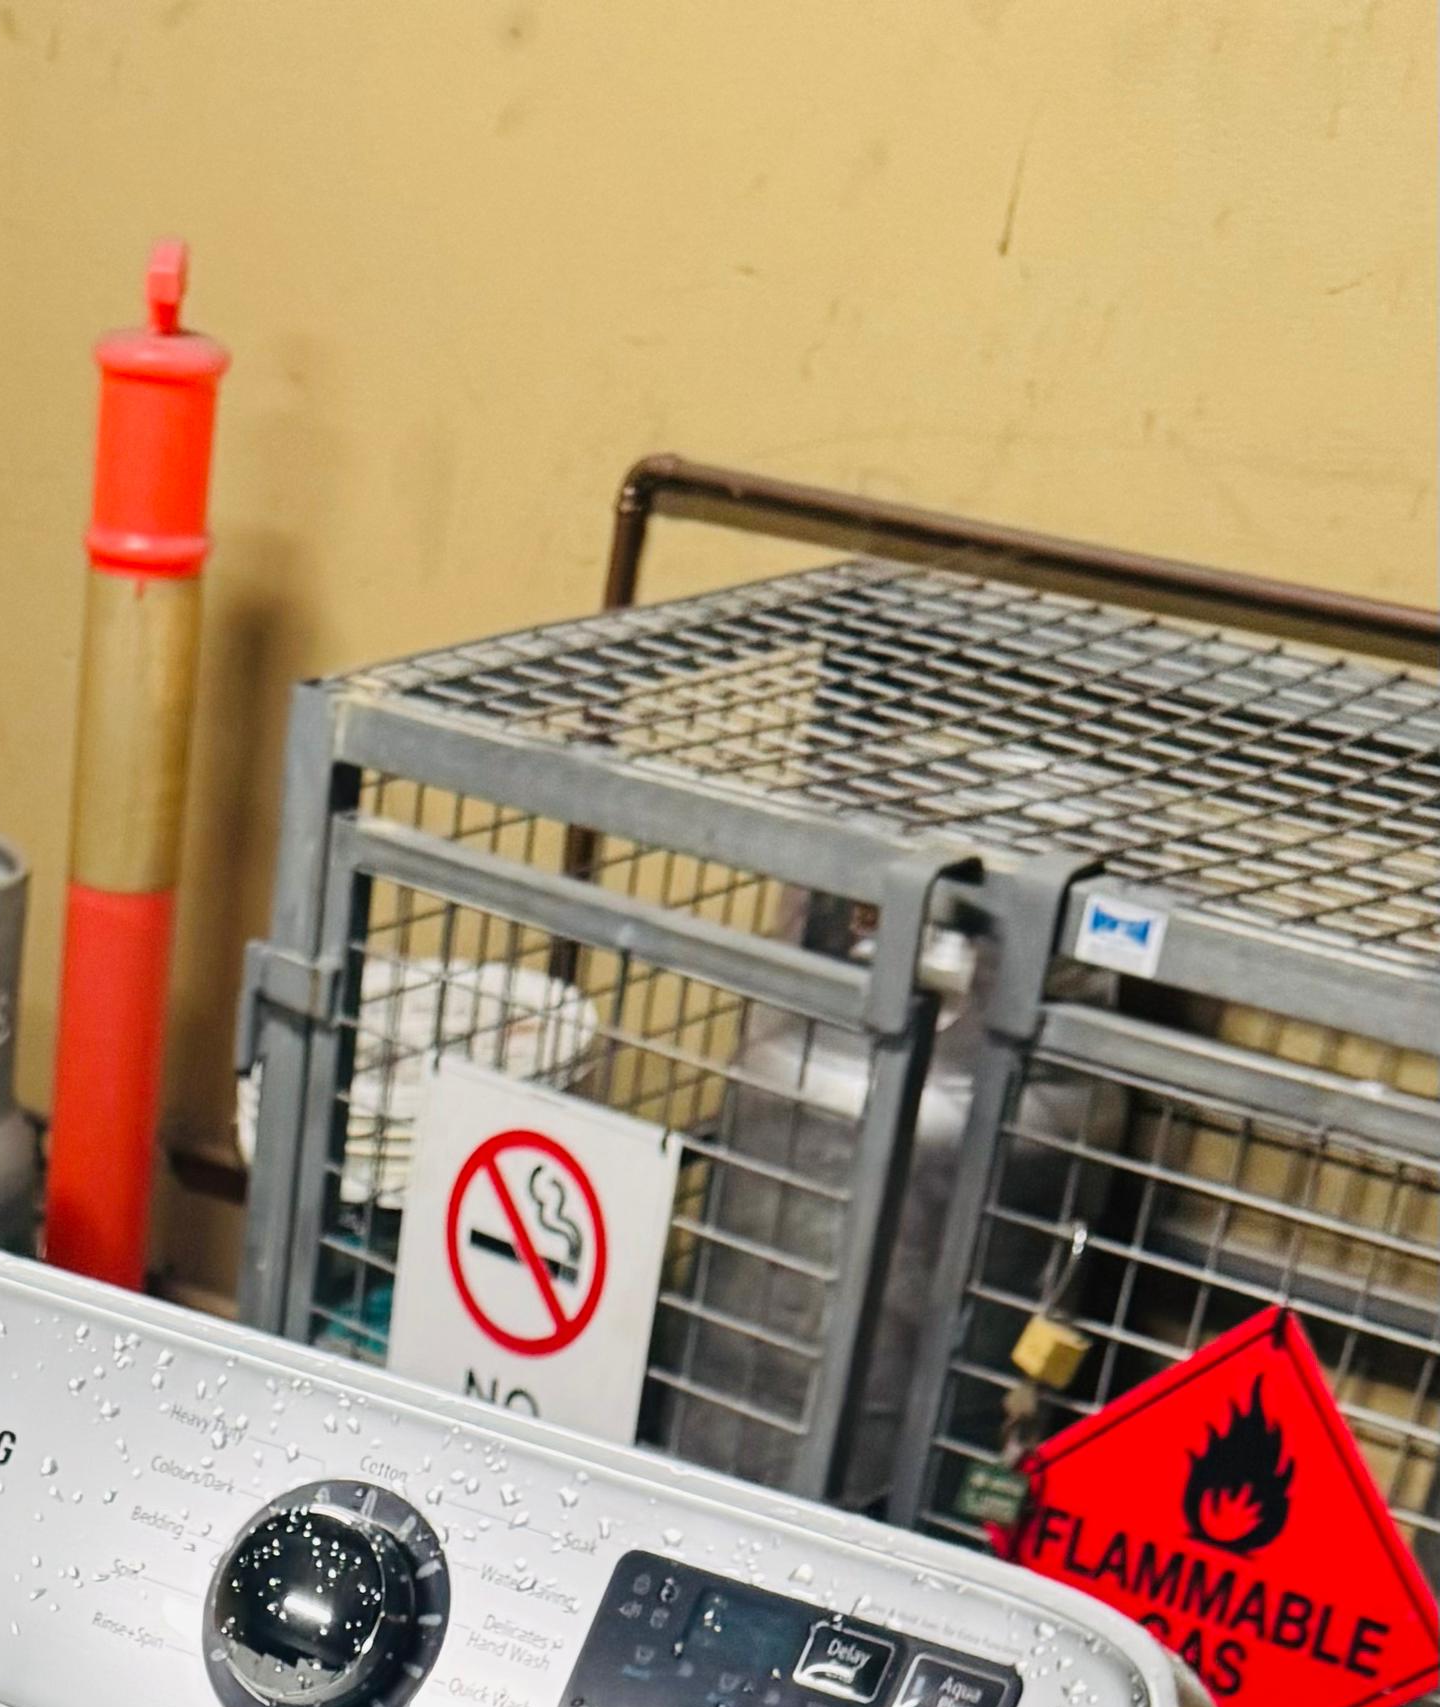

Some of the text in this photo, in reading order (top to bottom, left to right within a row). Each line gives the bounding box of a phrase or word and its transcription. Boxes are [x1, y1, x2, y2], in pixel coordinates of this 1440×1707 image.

[171, 1404, 209, 1434] Heavy
[151, 1455, 236, 1494] Colours/Dark
[360, 1454, 409, 1482] Cotton
[131, 1505, 185, 1540] Bedding
[562, 1532, 598, 1556] Soak
[111, 1558, 141, 1580] Sp
[481, 1562, 530, 1592] Wate
[1031, 1509, 1390, 1678] FLAMMABLE
[467, 1631, 552, 1671] Hand Wash
[827, 1637, 871, 1670] Delay
[449, 1677, 488, 1705] Quick
[939, 1675, 983, 1704] Aqua
